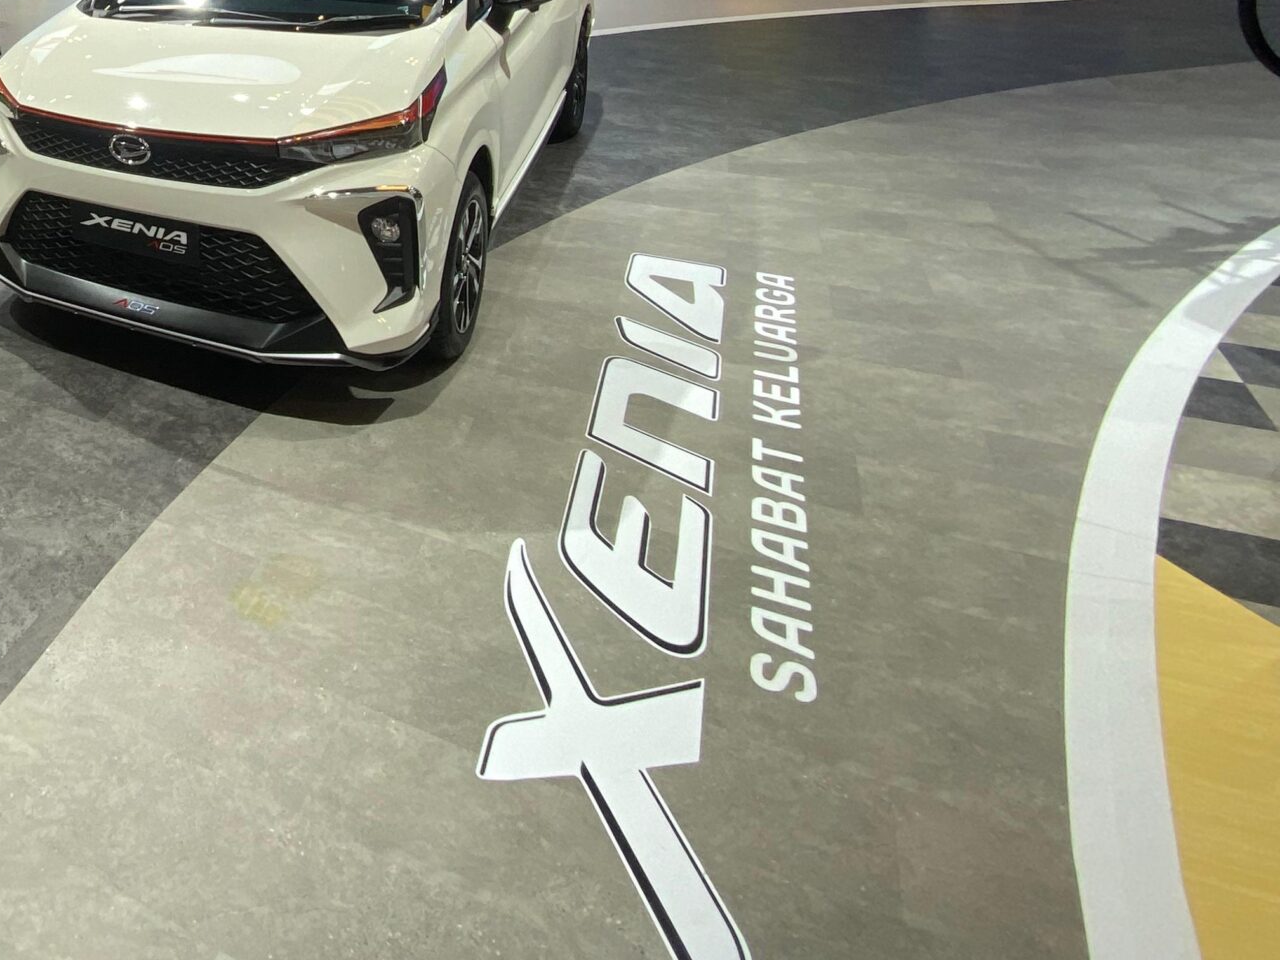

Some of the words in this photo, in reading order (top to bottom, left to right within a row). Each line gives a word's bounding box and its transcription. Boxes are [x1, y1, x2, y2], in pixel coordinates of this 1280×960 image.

[80, 212, 188, 245] XENIA
[751, 271, 802, 430] KELUARGA
[749, 438, 818, 703] SAHABAT
